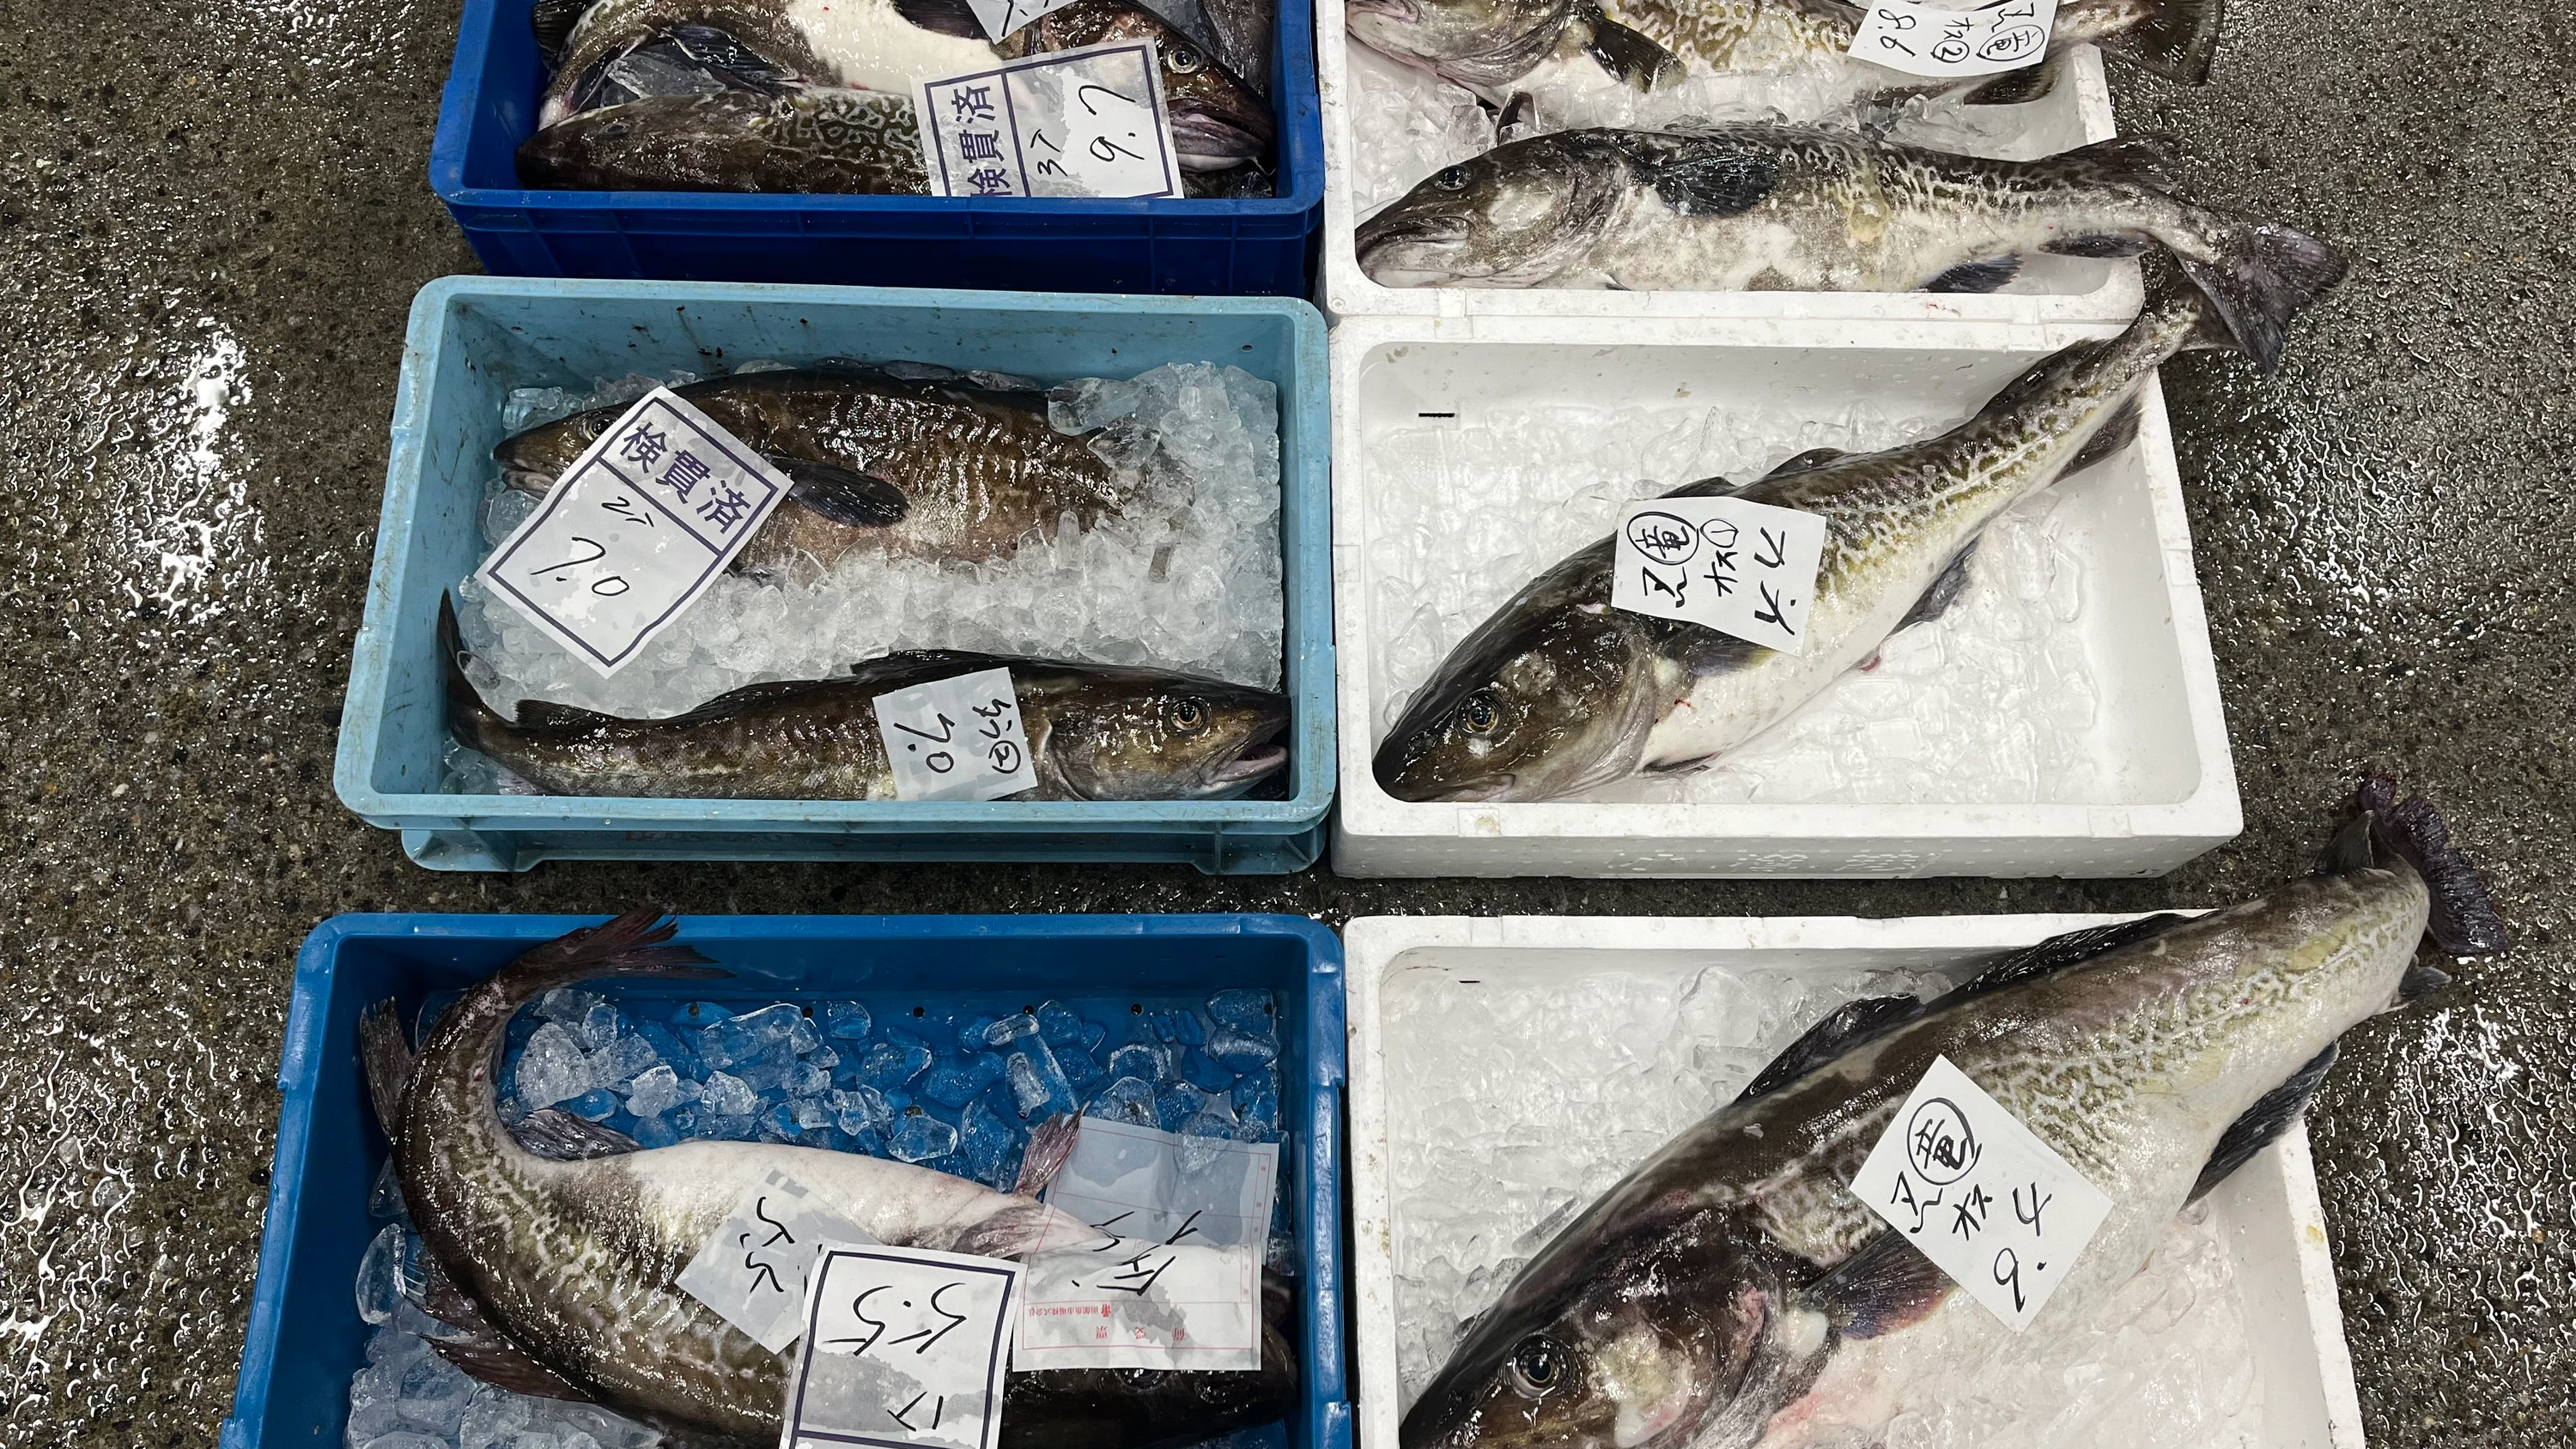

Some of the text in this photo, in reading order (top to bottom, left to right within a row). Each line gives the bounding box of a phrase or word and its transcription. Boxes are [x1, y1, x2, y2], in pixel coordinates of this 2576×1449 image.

[1078, 84, 1145, 162] 9.7
[619, 421, 752, 534] 検貫済
[530, 537, 629, 597] 7.0
[893, 712, 955, 773] 7.0
[823, 1282, 967, 1356] 5.5
